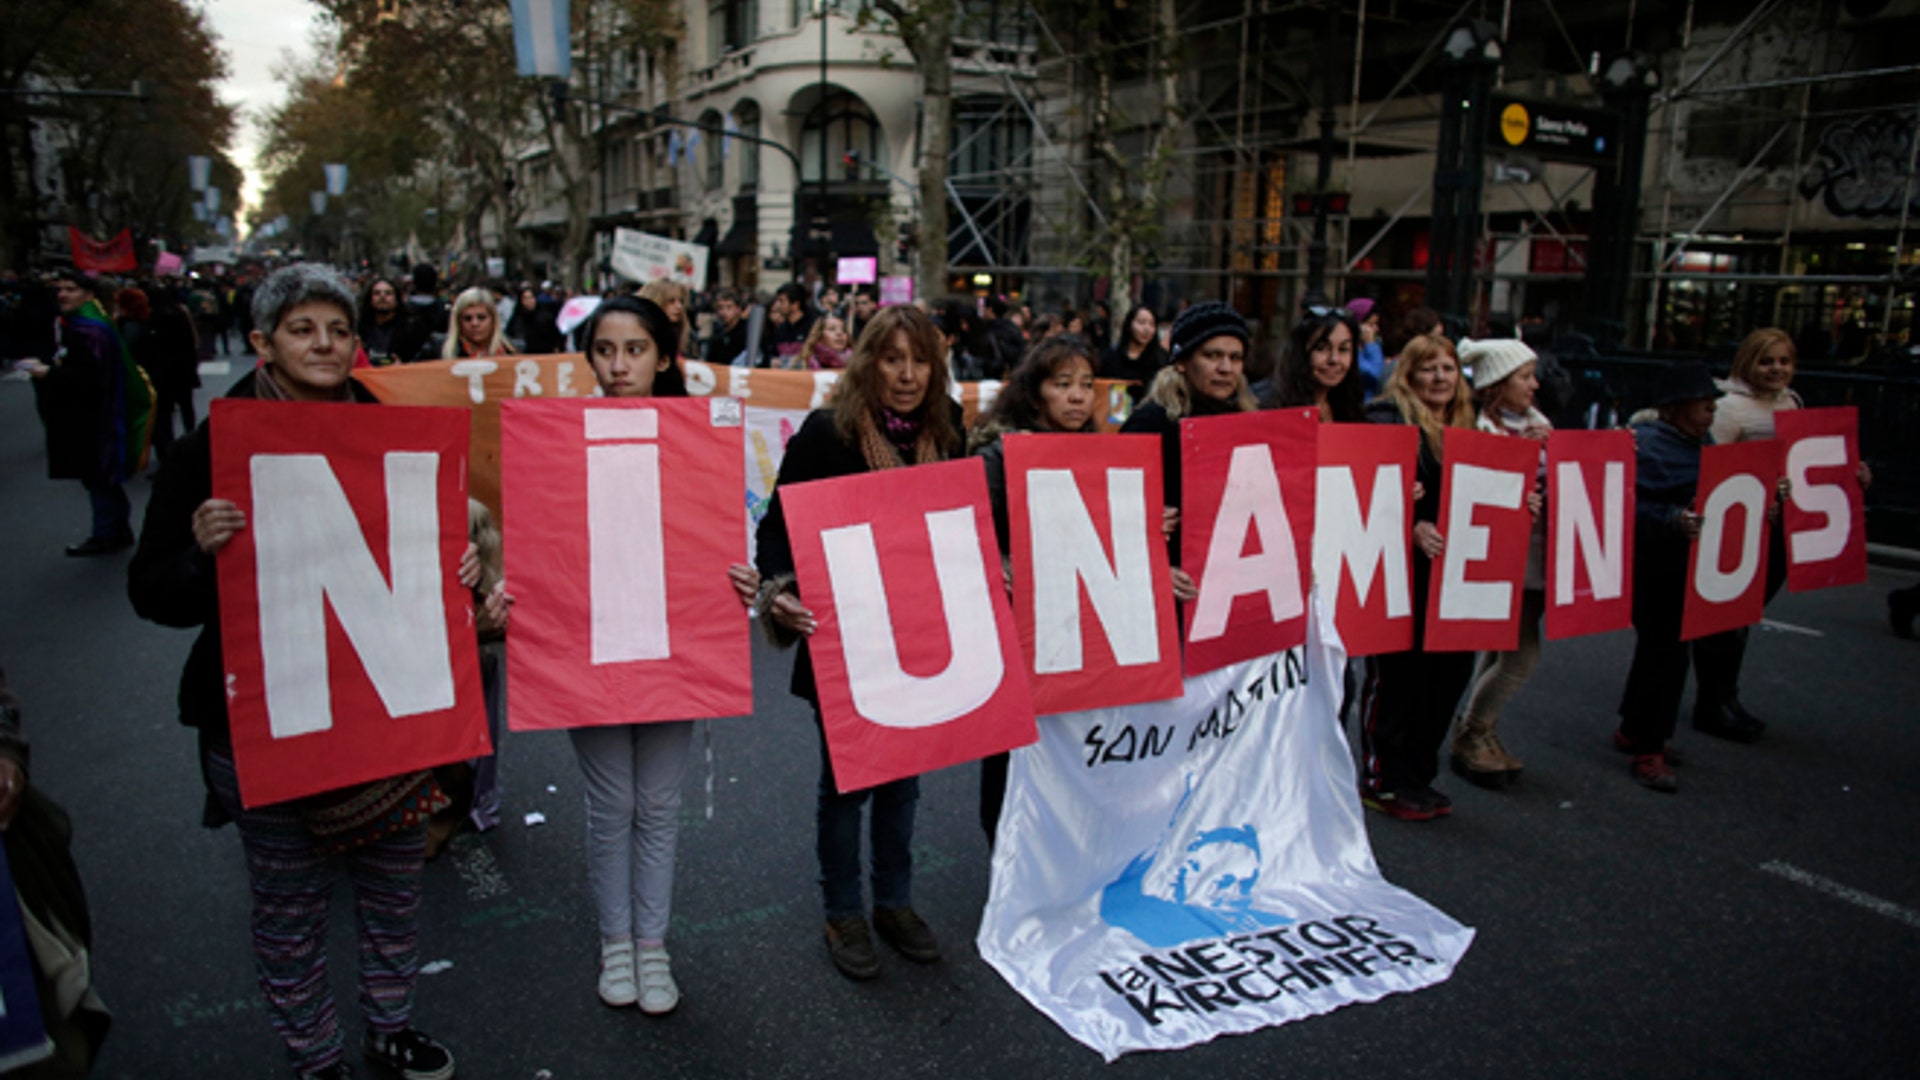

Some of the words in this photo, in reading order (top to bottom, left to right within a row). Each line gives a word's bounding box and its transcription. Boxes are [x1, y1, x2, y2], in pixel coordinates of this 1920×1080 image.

[684, 360, 751, 398] DE
[1084, 723, 1175, 767] SAN
[1141, 914, 1398, 984] NESTOR
